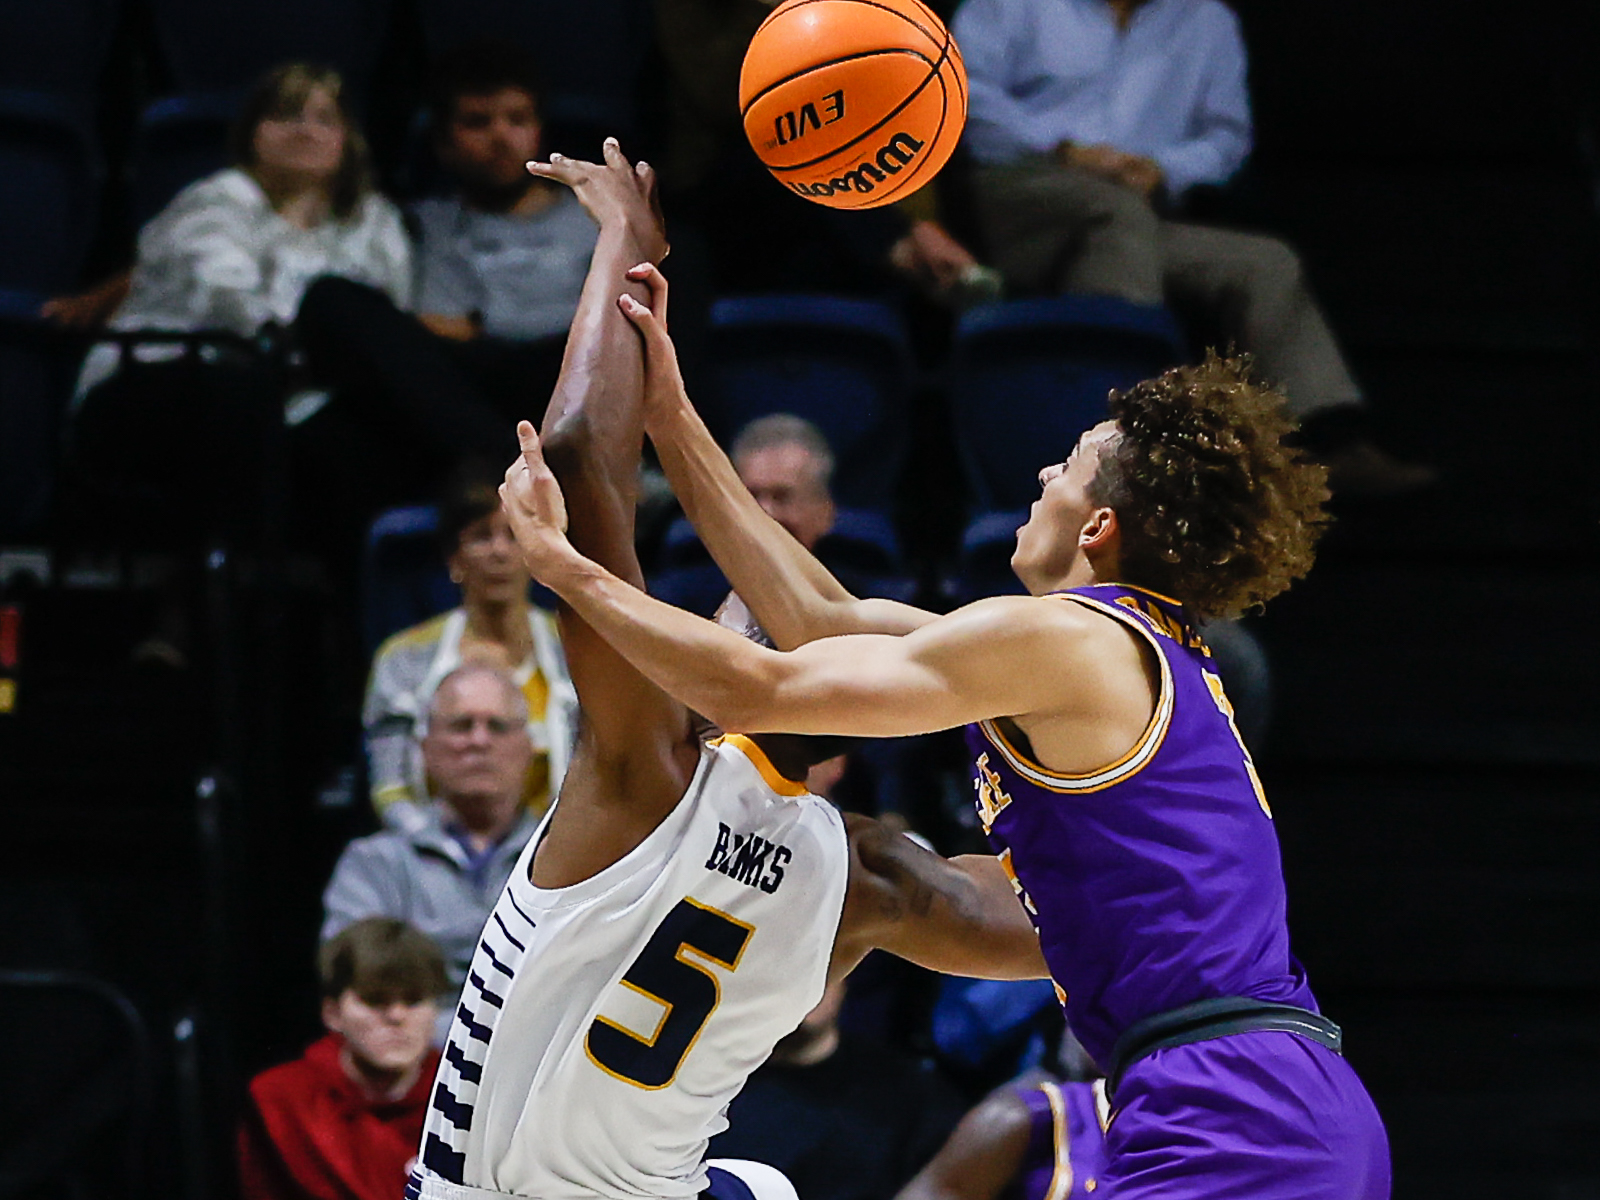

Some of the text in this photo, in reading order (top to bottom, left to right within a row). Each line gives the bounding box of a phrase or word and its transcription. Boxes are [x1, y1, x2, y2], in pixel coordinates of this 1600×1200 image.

[774, 89, 844, 146] EVO
[787, 131, 925, 197] Wilson
[583, 896, 756, 1091] 5
